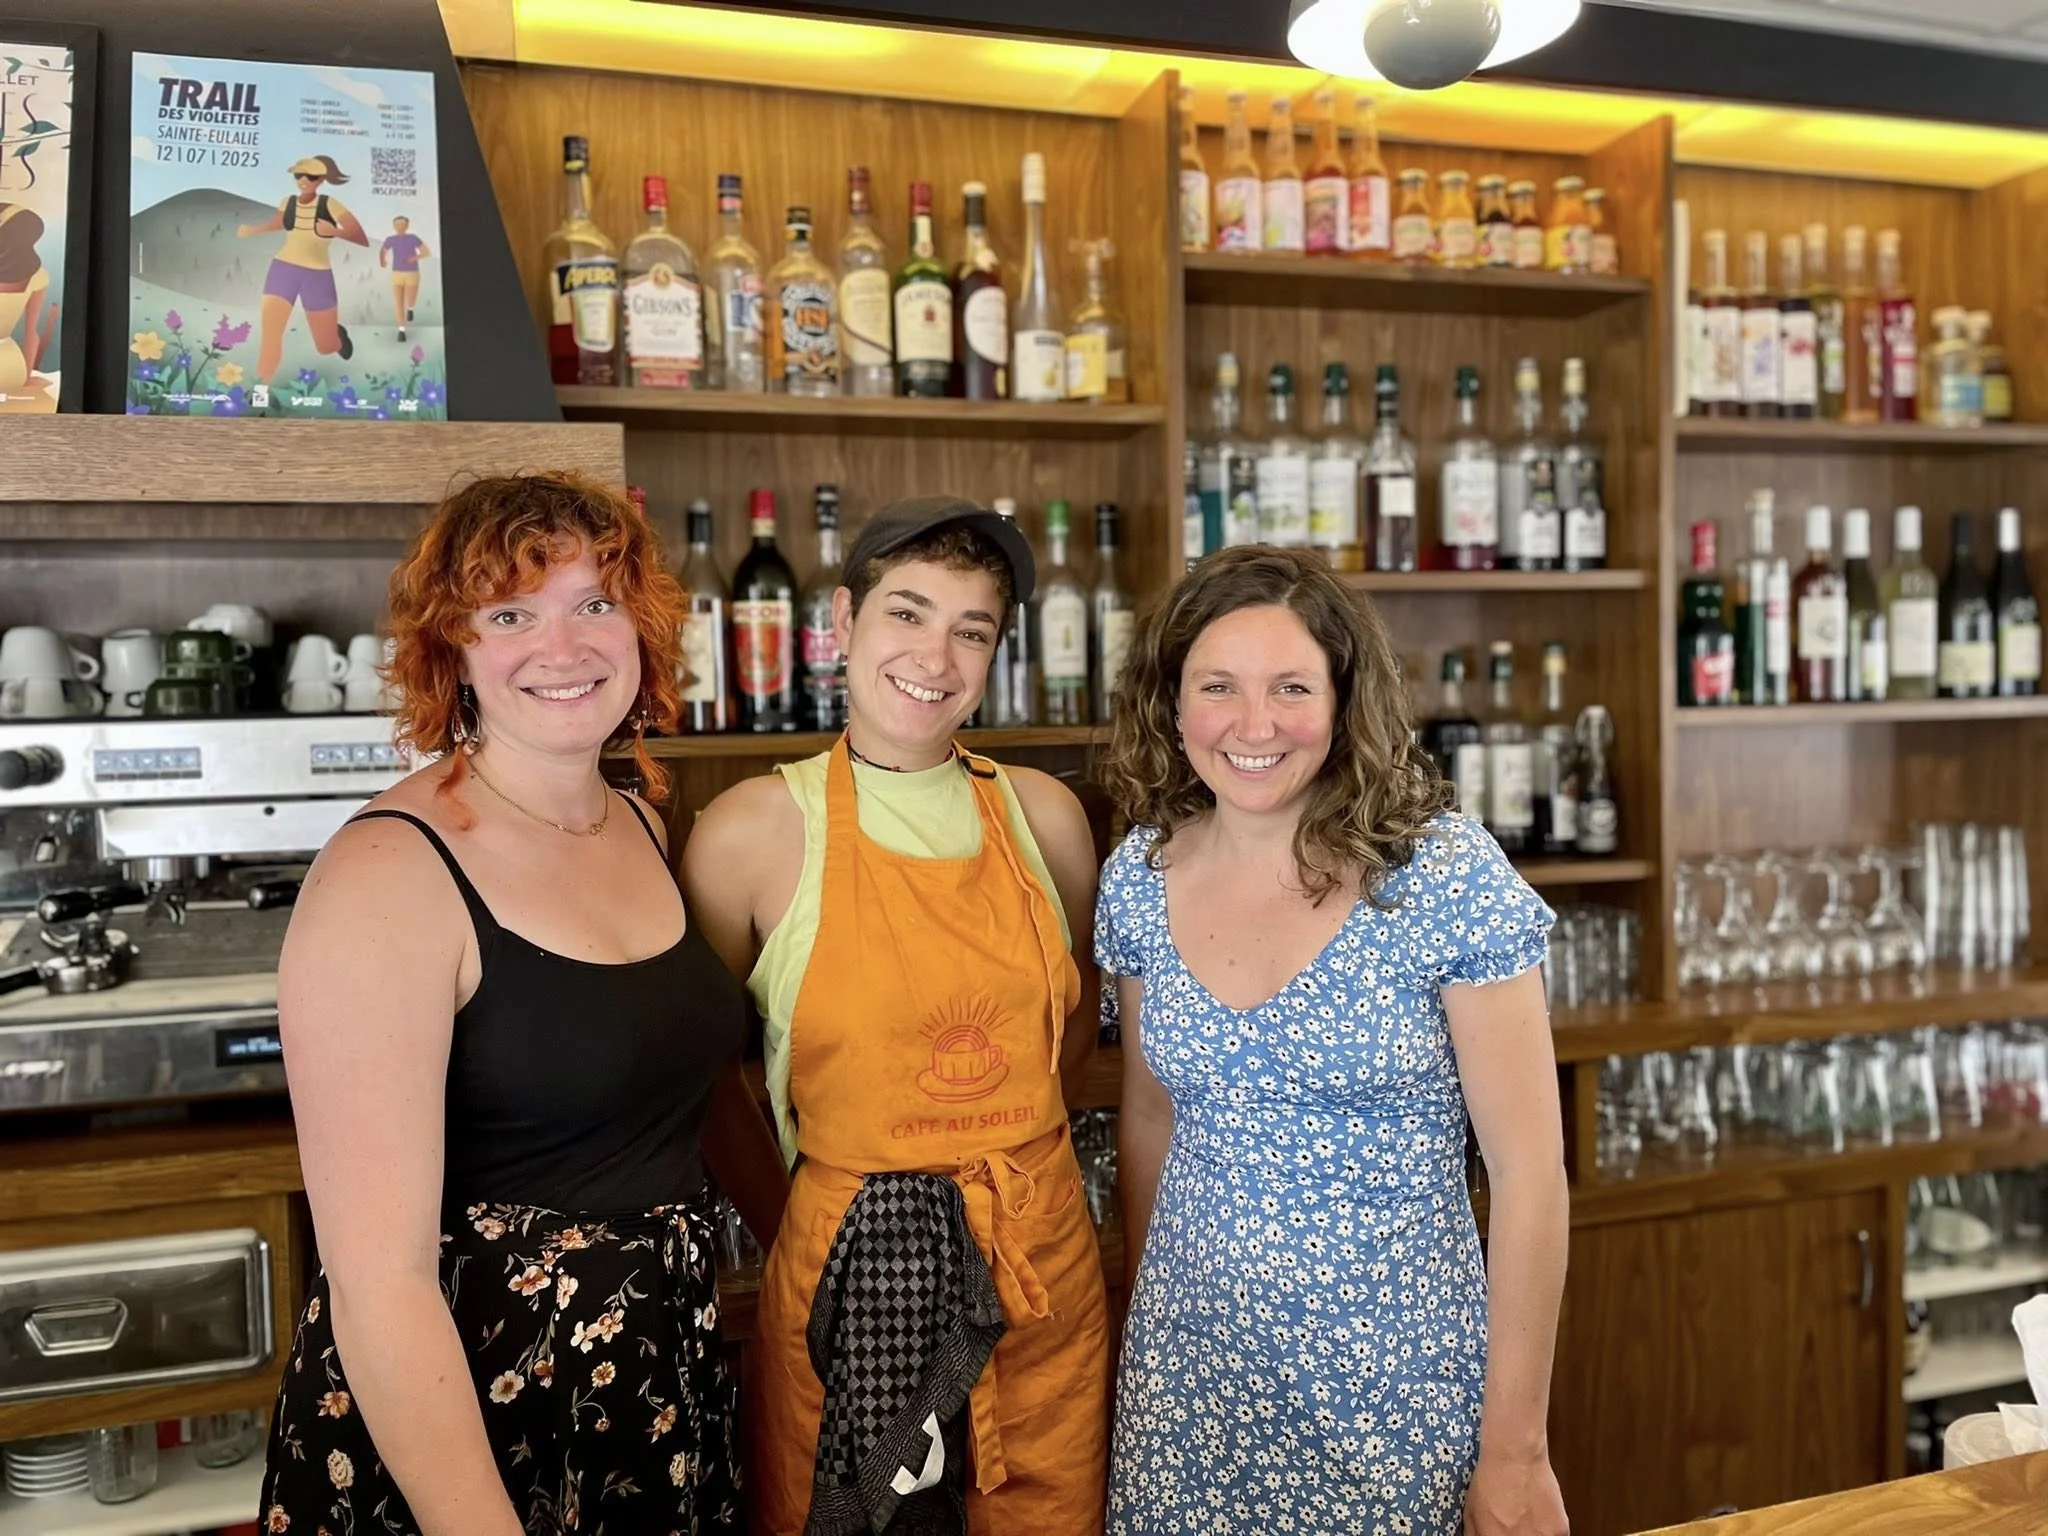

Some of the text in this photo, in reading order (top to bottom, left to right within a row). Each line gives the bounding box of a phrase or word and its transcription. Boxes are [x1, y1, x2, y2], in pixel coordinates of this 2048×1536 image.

[158, 77, 261, 113] TRAIL
[158, 107, 260, 126] DES VIOLETTES
[157, 125, 260, 146] SAINTE-EULALIE
[157, 144, 173, 162] 12
[186, 148, 207, 165] 07
[221, 150, 260, 168] 2025
[371, 187, 417, 197] INSCRIPTION
[946, 1115, 974, 1132] AU
[978, 1105, 1040, 1129] SOLEIL
